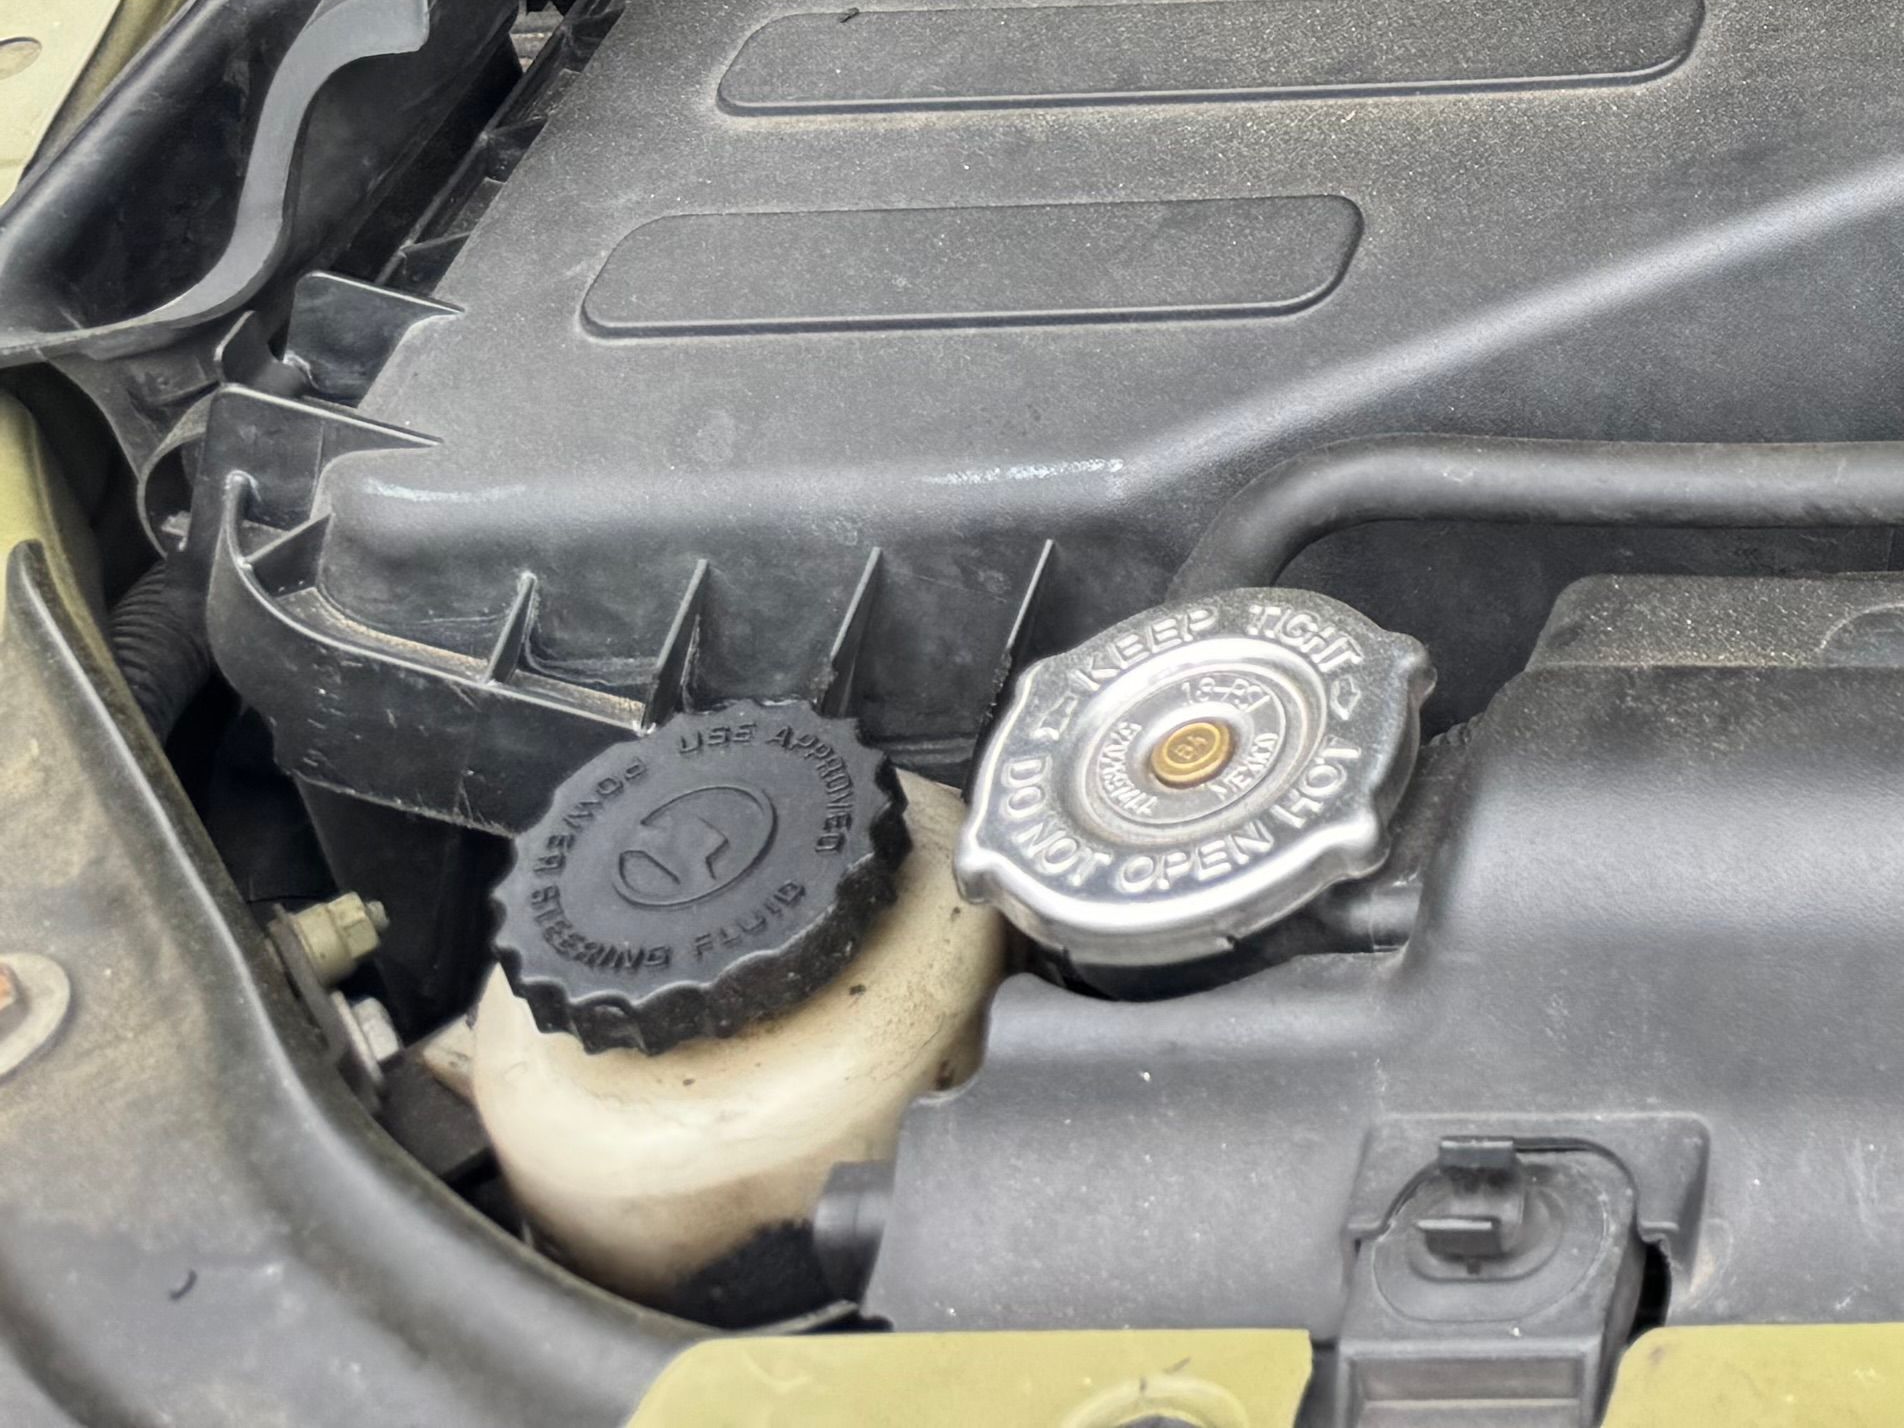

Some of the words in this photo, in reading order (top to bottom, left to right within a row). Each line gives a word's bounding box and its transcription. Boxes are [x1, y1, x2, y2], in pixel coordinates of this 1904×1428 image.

[1080, 606, 1221, 693] KEEP
[1248, 604, 1365, 681] TIGHT
[532, 754, 650, 879] POWER
[676, 720, 758, 754] USE
[764, 724, 855, 856] APPROVED
[1001, 756, 1044, 820] DO
[1270, 734, 1364, 830] HOT
[1011, 822, 1112, 887] NOT
[1119, 818, 1278, 894] OPEN
[529, 883, 674, 971] STEERING
[692, 879, 808, 961] FLUID
